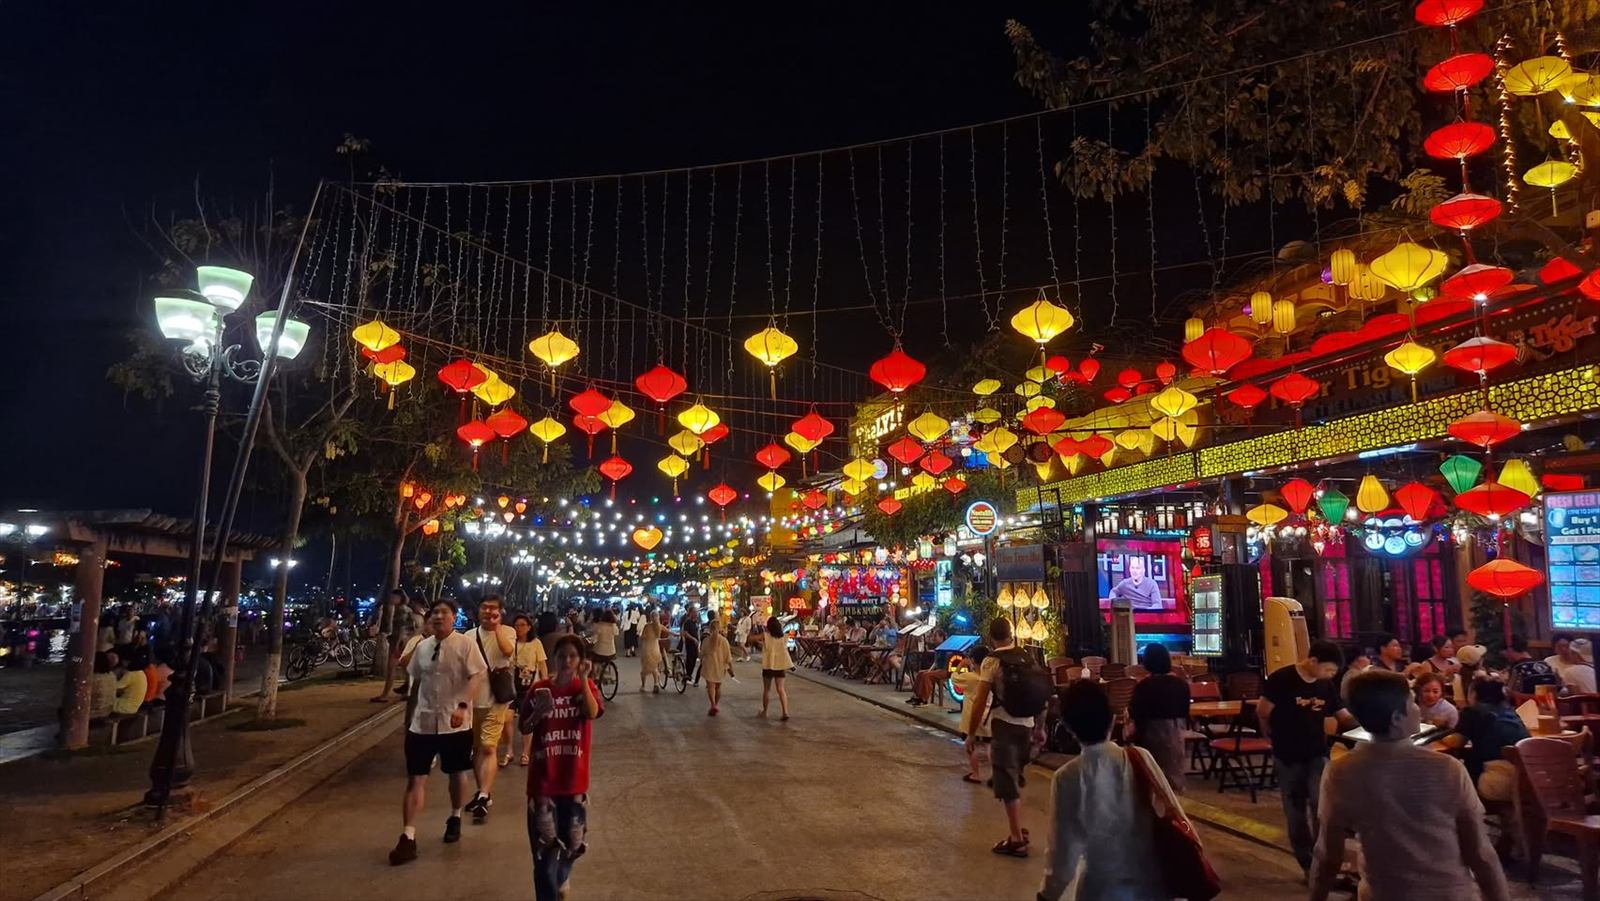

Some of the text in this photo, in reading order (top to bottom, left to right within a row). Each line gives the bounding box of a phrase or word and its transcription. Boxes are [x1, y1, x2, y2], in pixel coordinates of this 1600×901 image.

[1529, 314, 1598, 352] Tiger
[1574, 494, 1596, 507] BEER
[1571, 515, 1597, 525] Buy 1
[1561, 527, 1579, 535] Get
[789, 597, 807, 609] SPA
